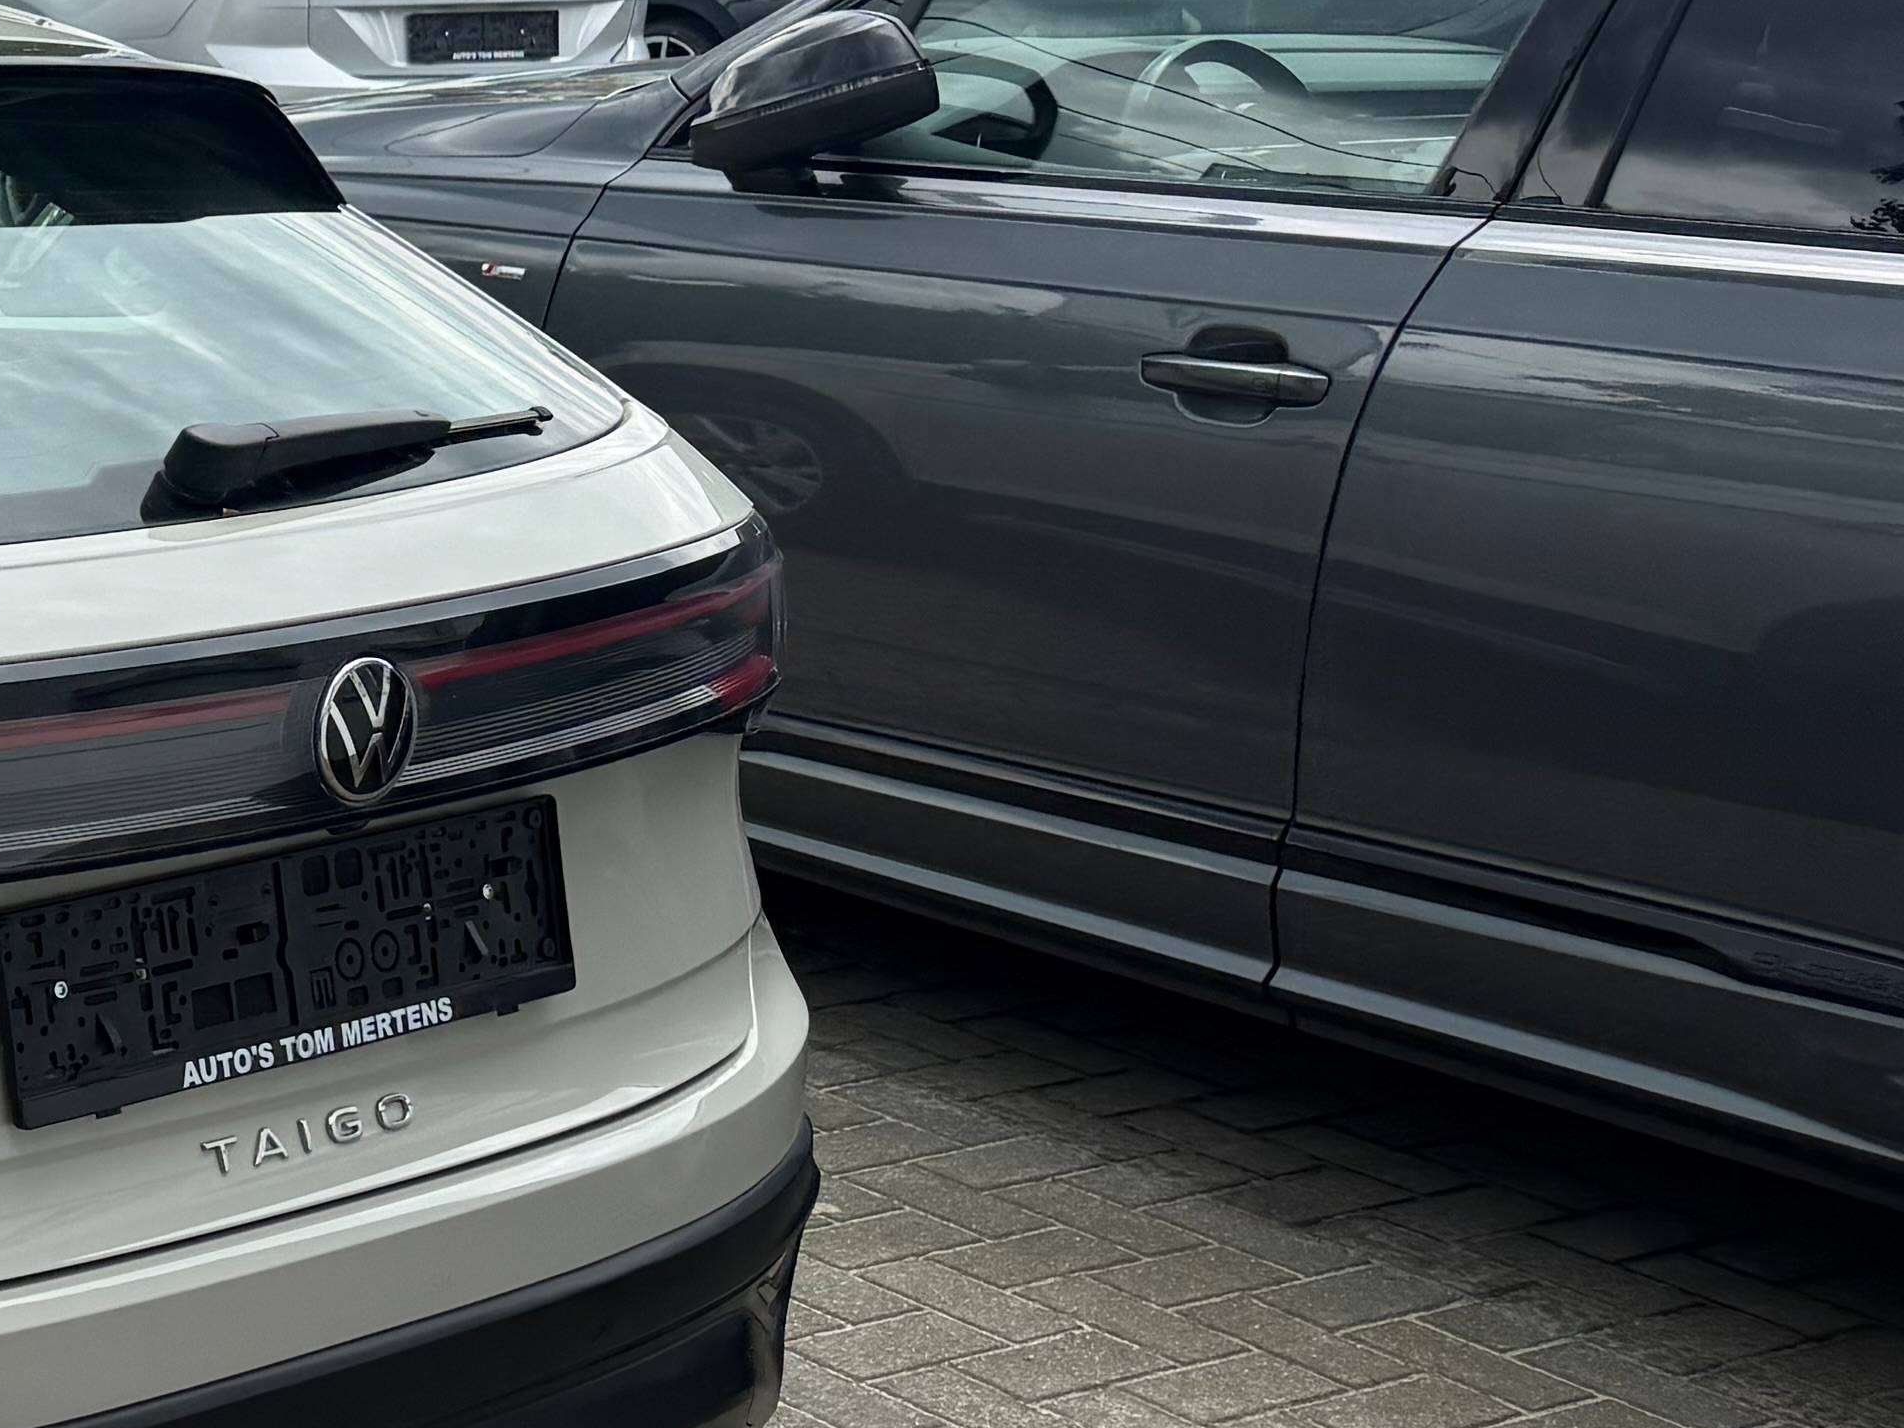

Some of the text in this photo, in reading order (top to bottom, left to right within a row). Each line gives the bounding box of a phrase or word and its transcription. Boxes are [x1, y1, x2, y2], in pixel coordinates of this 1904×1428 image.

[183, 997, 453, 1089] AUTO'S TOM MERTENS
[200, 1093, 414, 1175] TAIGO
